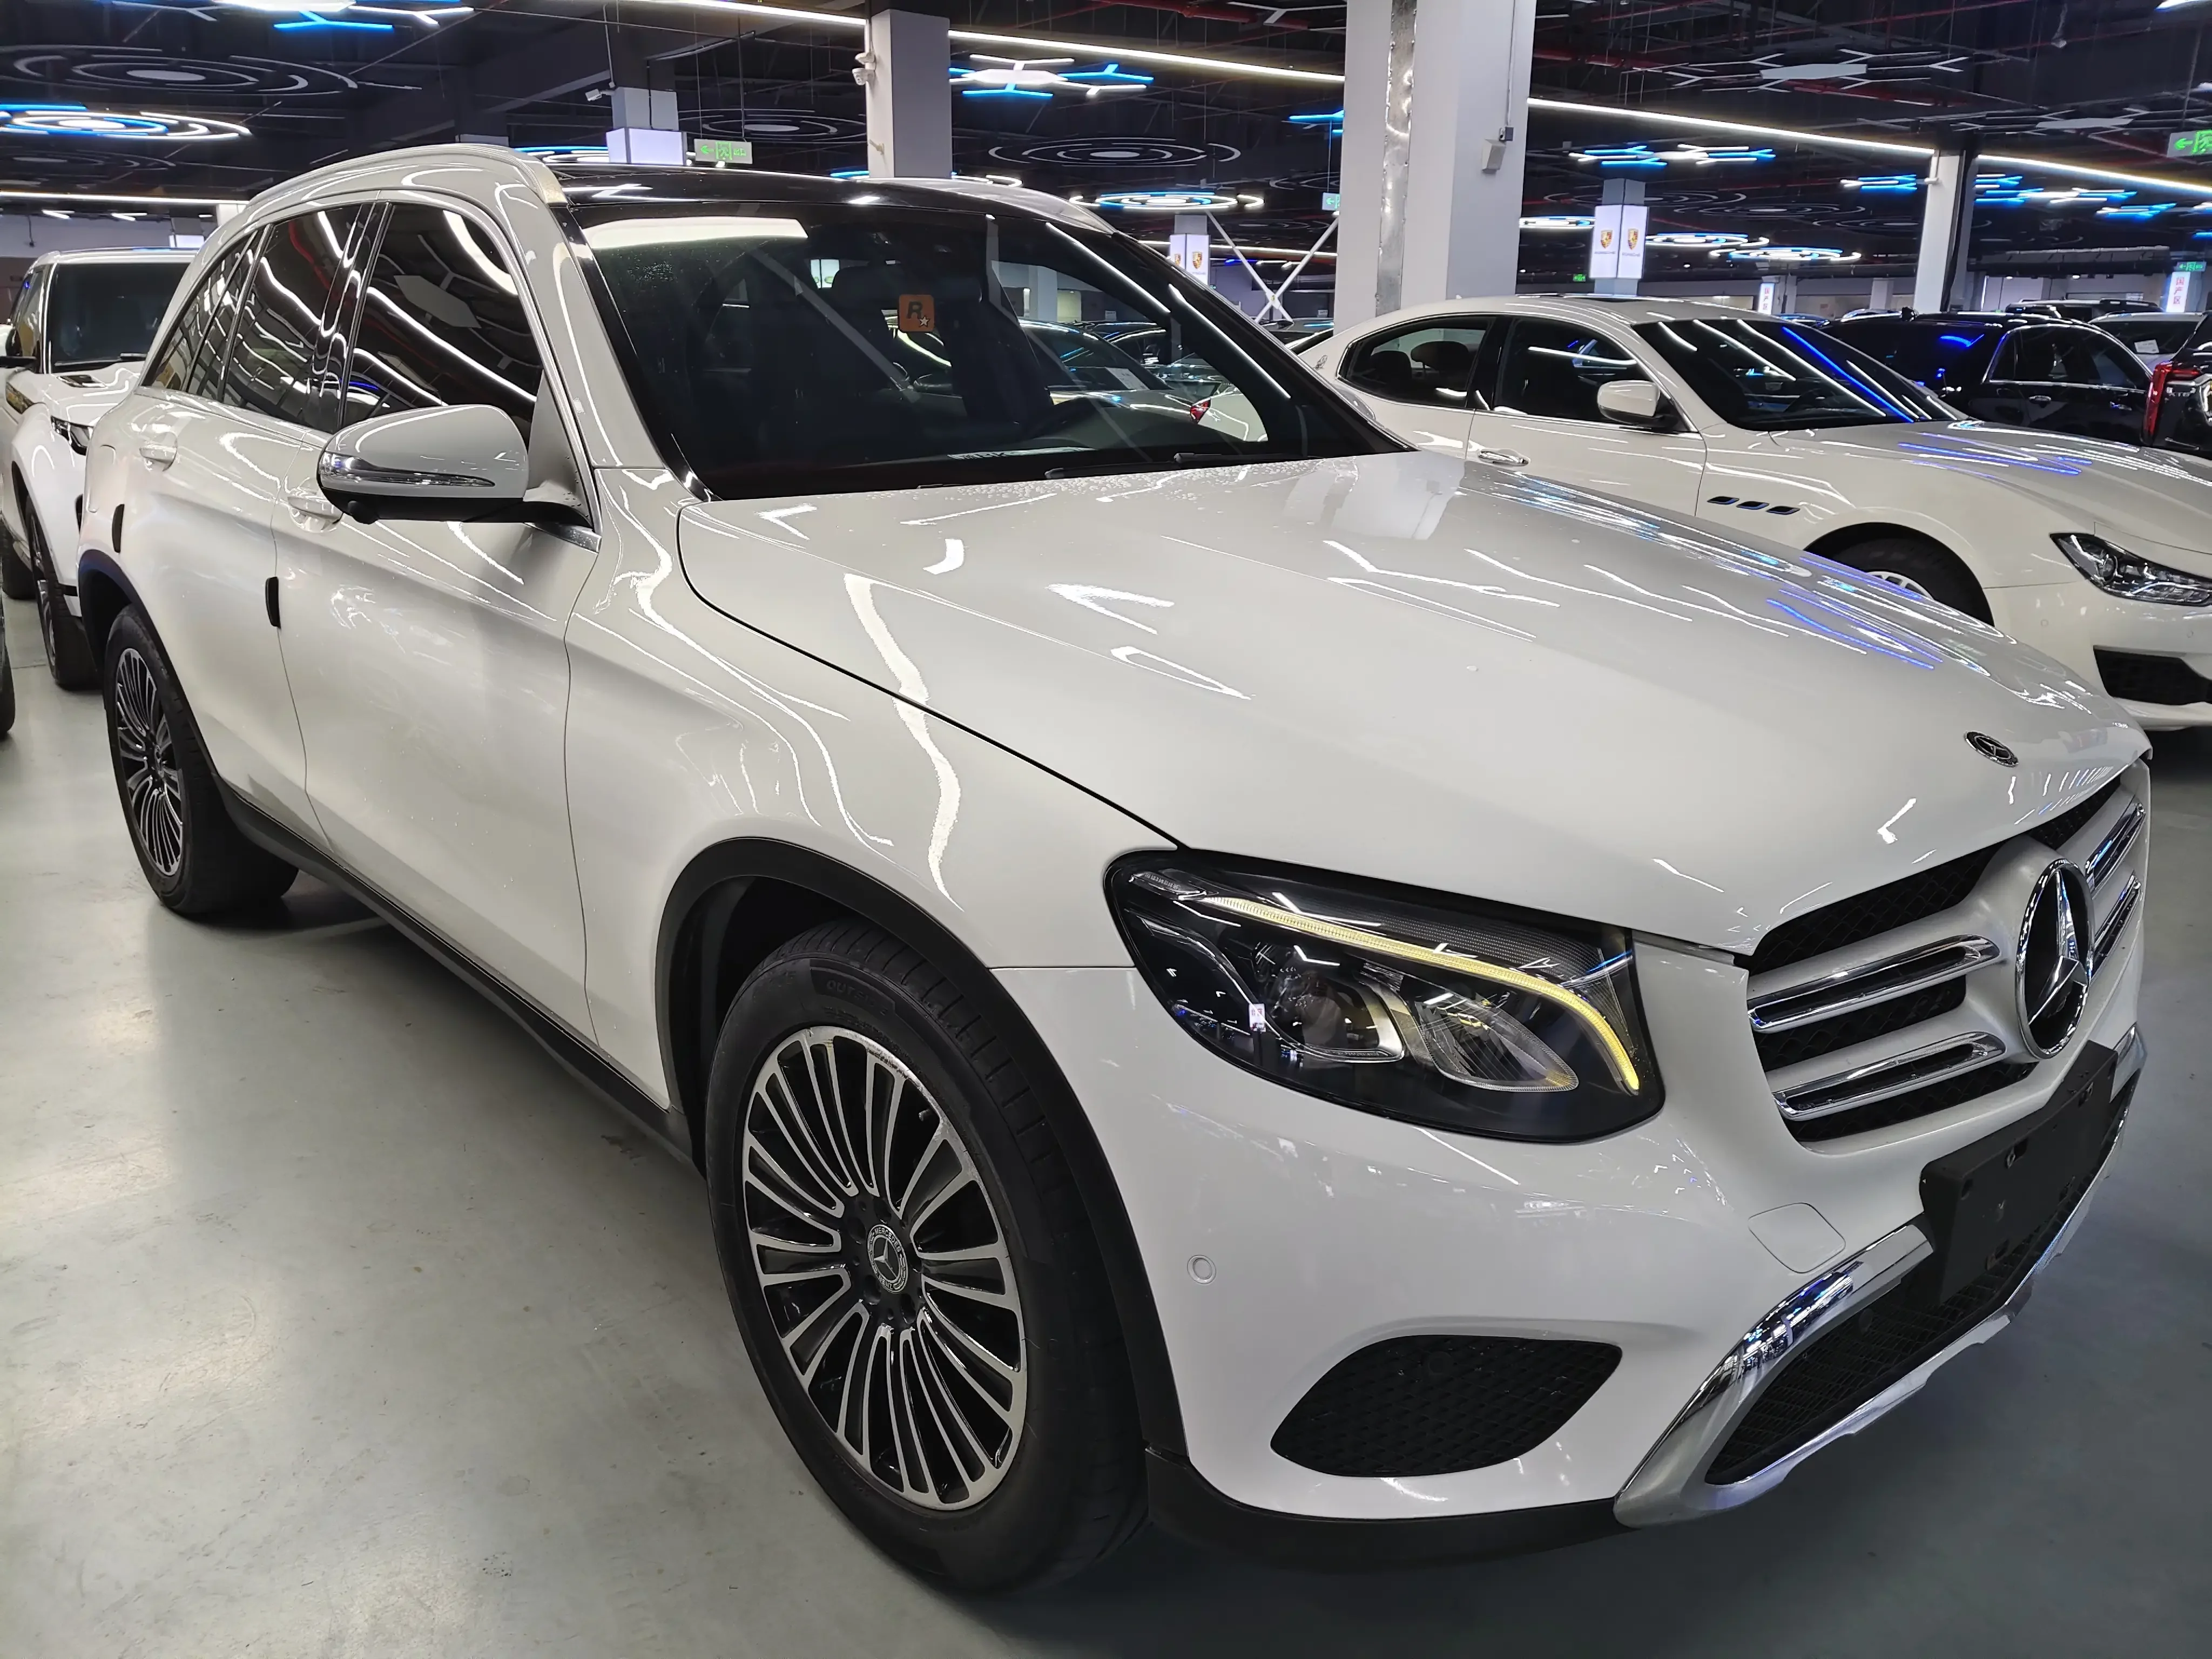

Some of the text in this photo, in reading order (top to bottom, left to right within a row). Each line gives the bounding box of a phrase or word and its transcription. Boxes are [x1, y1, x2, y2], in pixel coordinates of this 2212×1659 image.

[906, 301, 923, 320] R
[874, 1227, 901, 1252] MERCEDES
[879, 1274, 894, 1290] BENZ
